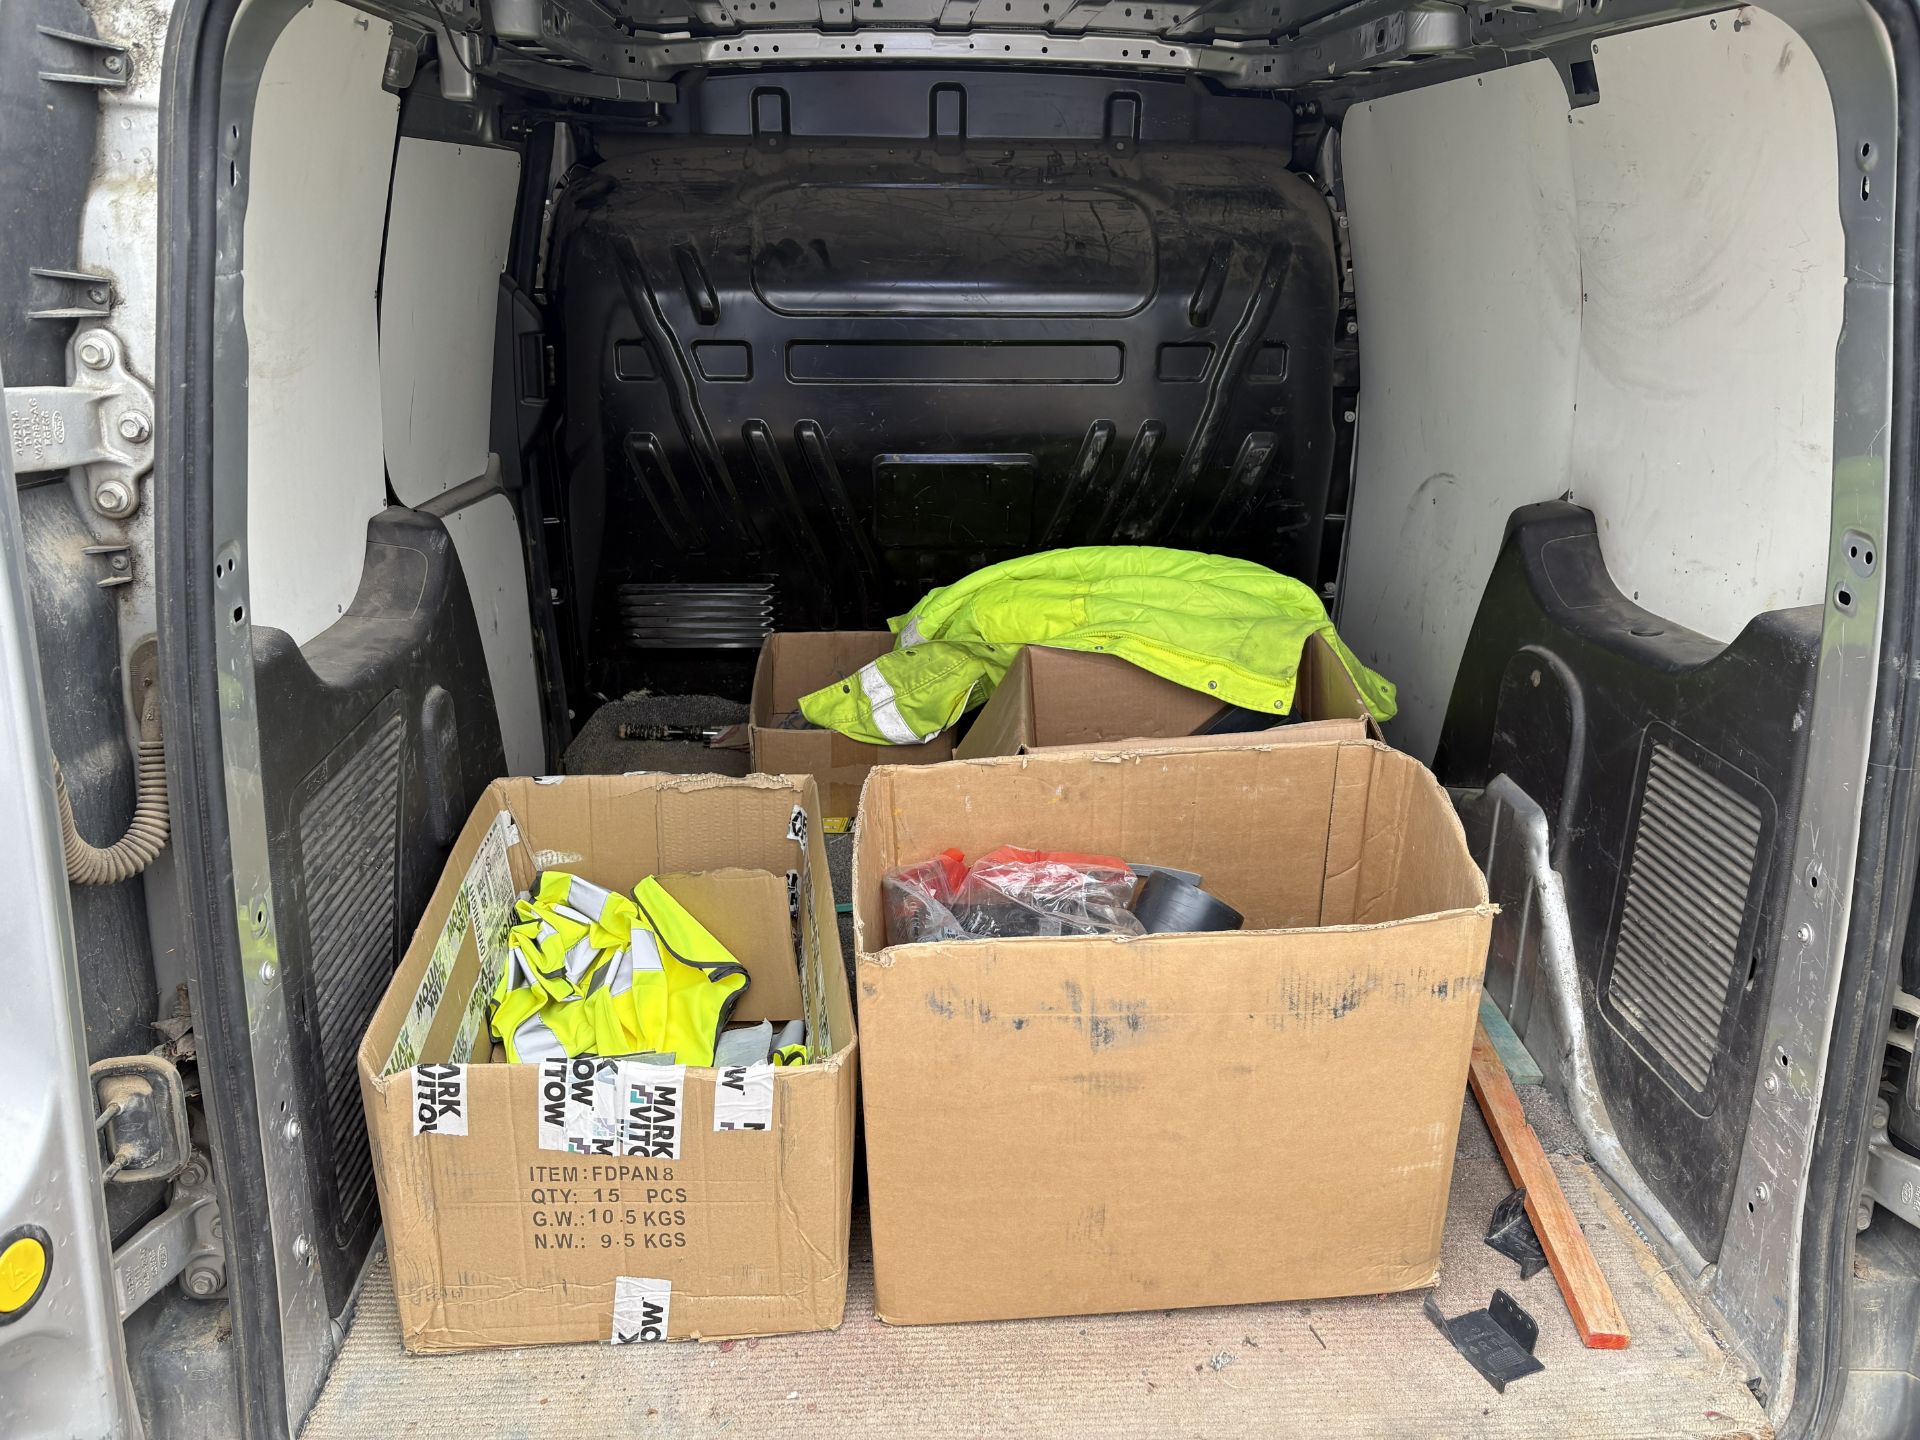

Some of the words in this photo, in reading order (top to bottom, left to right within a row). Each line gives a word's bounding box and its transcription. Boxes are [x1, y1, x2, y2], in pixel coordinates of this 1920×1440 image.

[470, 883, 486, 957] OVERNIGHT
[415, 961, 441, 1021] VITOW
[429, 963, 447, 1018] MARK
[651, 1086, 677, 1159] MARK
[531, 1188, 577, 1205] QTY:
[594, 1188, 620, 1203] 15
[647, 1188, 687, 1203] PCS
[644, 1210, 686, 1226] KGS
[534, 1233, 585, 1249] N.W.:
[601, 1233, 635, 1248] 9.5
[644, 1232, 686, 1248] KGS
